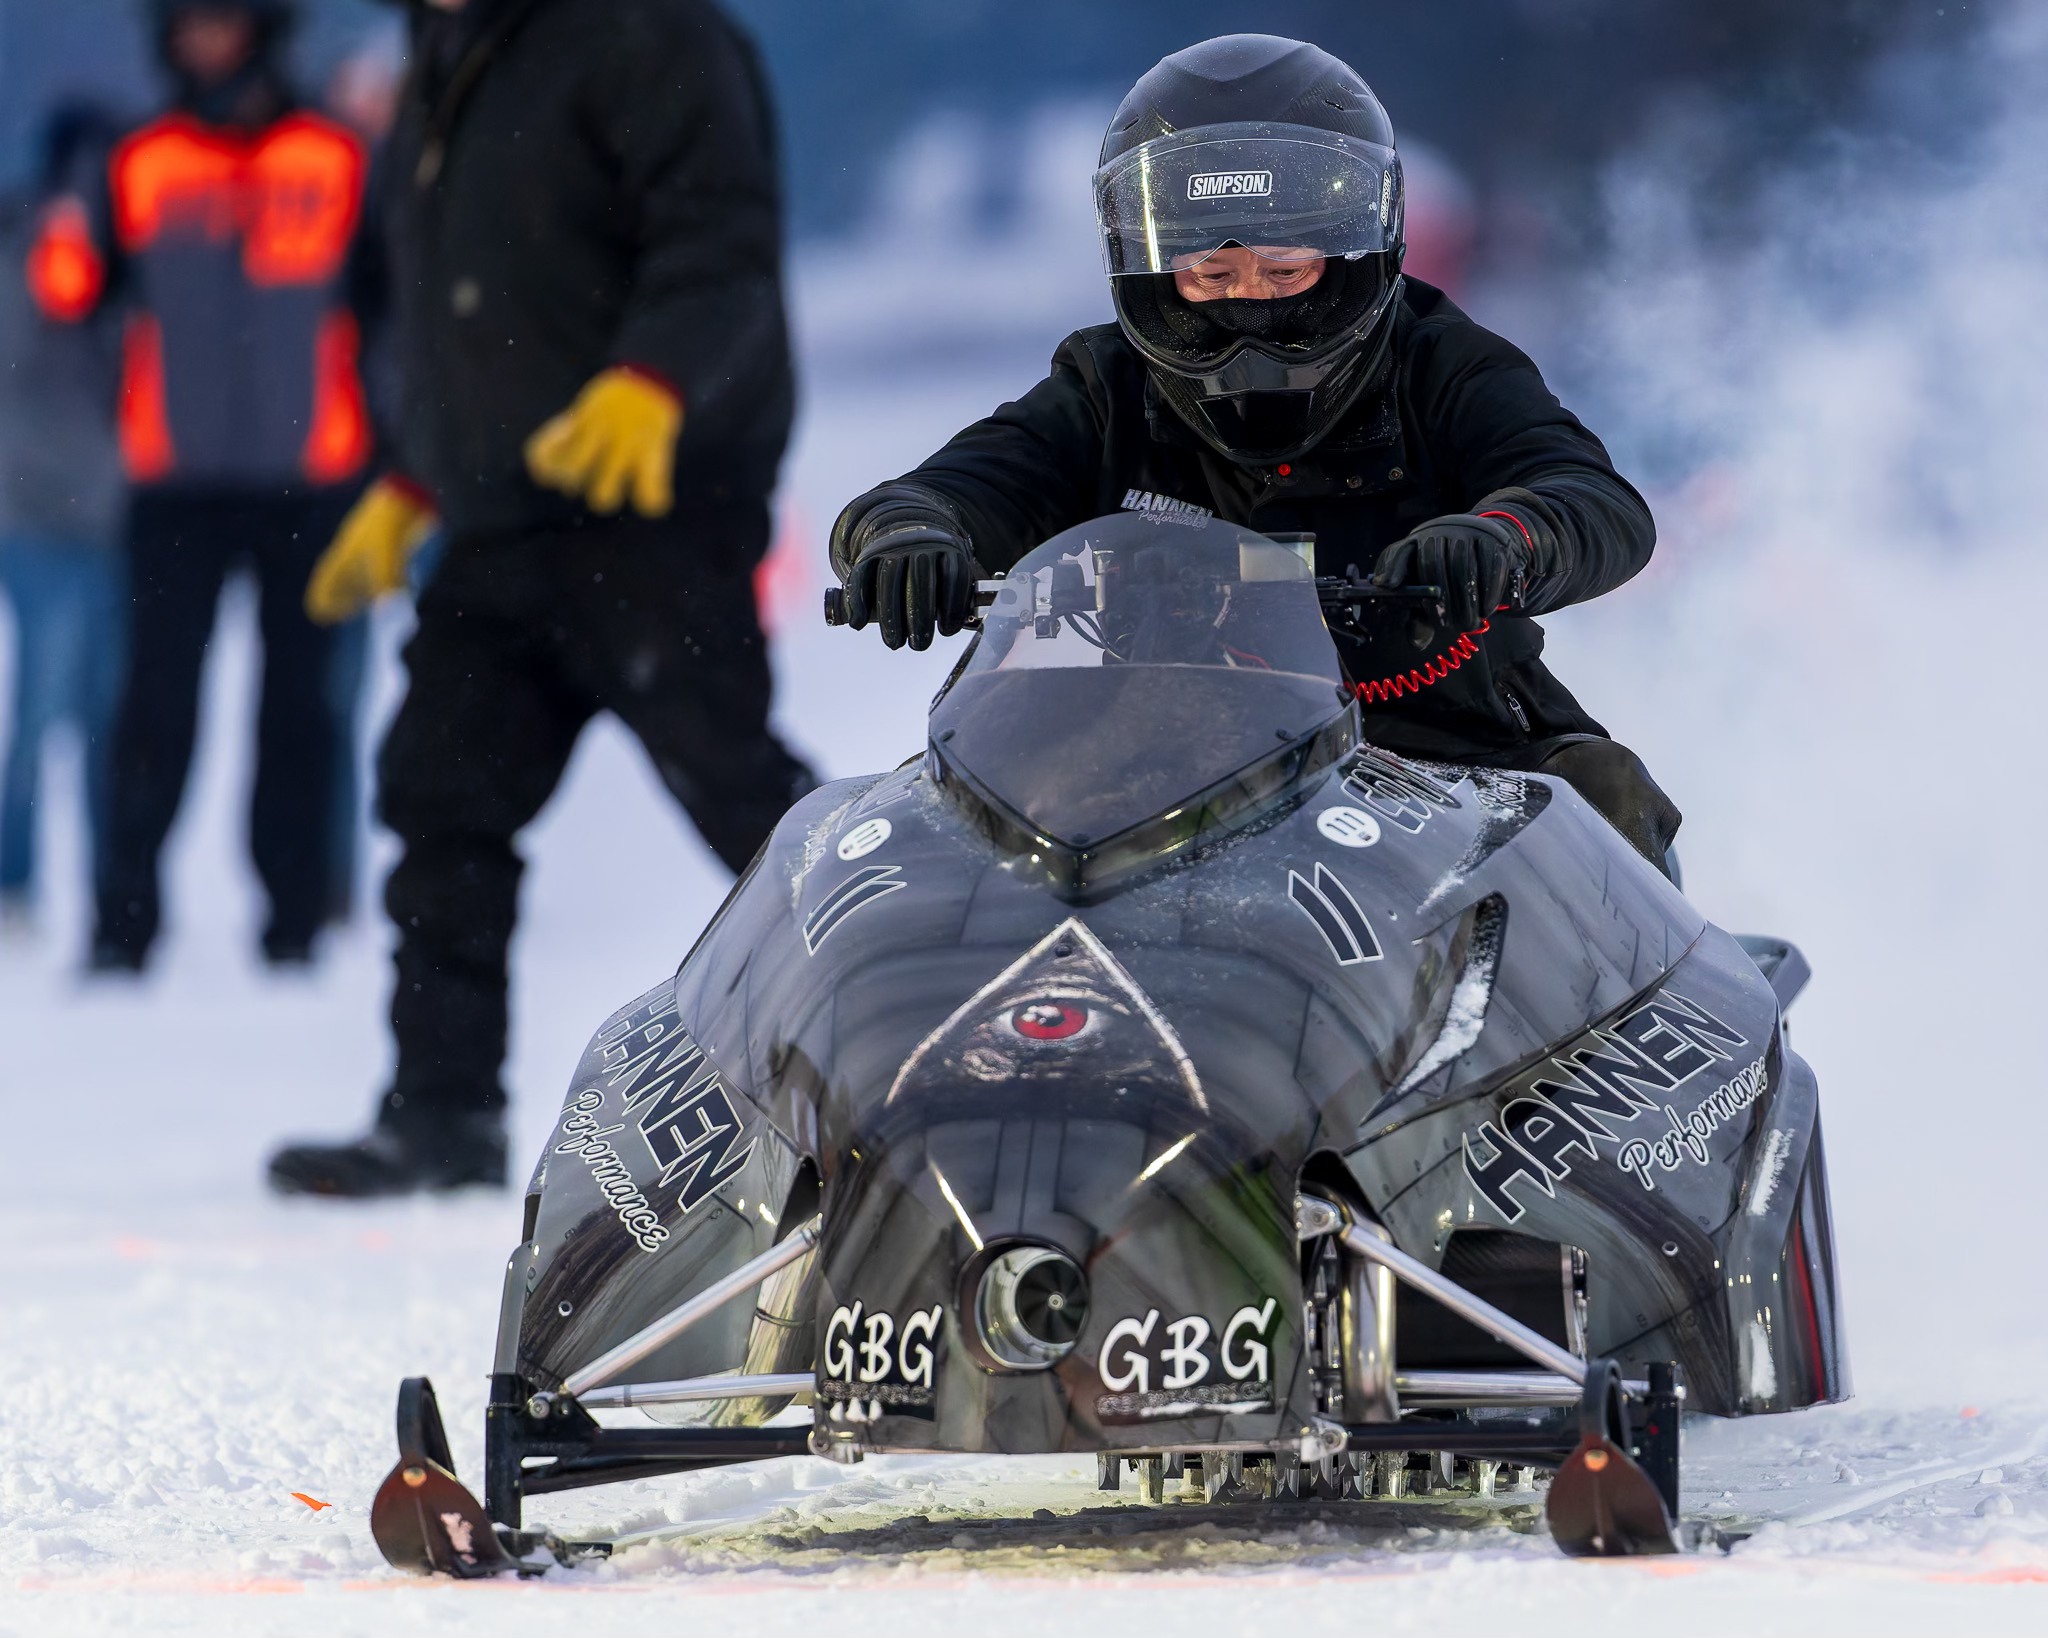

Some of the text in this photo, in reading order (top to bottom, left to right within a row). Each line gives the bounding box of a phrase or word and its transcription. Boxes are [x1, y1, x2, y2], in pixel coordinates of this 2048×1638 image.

[556, 1088, 670, 1253] Performance
[593, 990, 758, 1214] HANNEN
[1462, 988, 1749, 1224] HANNEN
[825, 1300, 943, 1389] GBG
[1098, 1297, 1277, 1394] GBG
